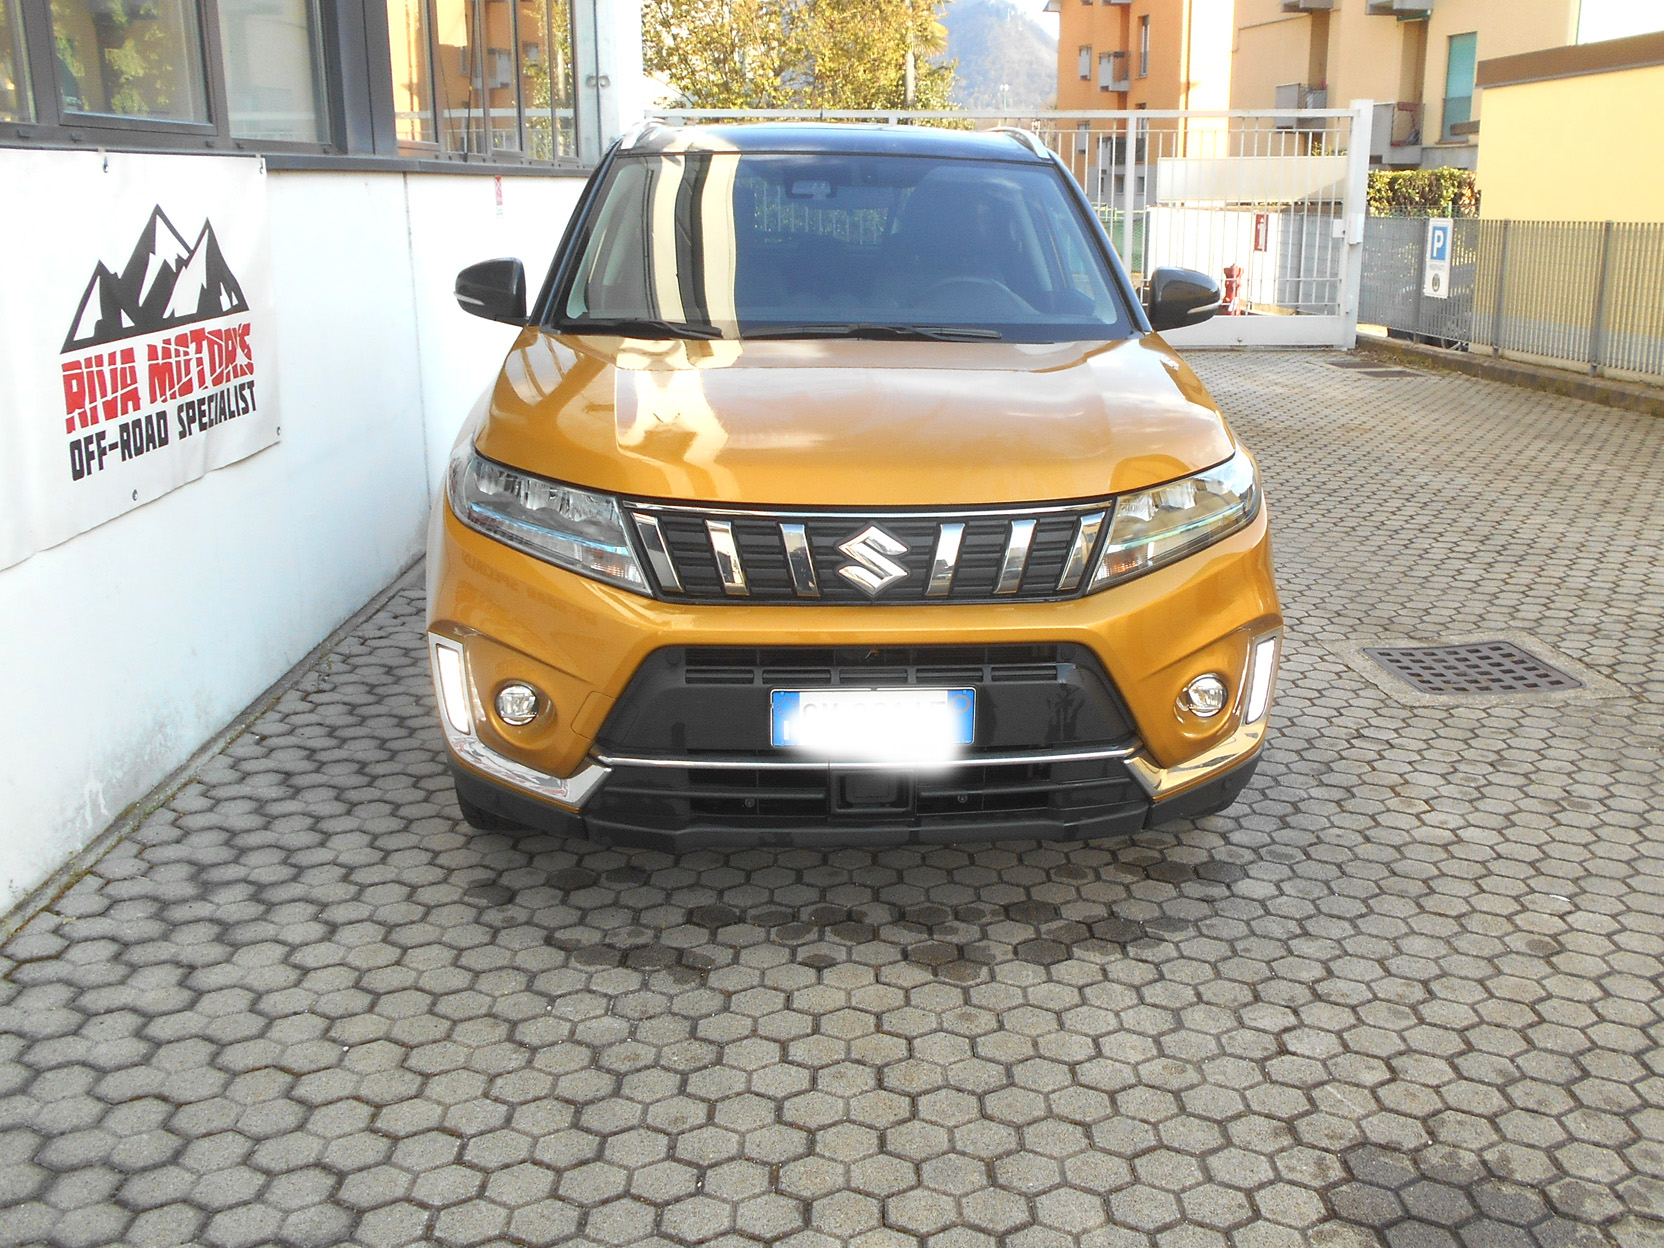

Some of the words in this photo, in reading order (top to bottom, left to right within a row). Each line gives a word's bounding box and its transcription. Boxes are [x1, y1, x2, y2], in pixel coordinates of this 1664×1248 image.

[1433, 230, 1445, 257] P
[61, 347, 141, 434] RIVA
[69, 410, 169, 481] OFF-ROAD
[177, 380, 256, 440] SPECIALIST
